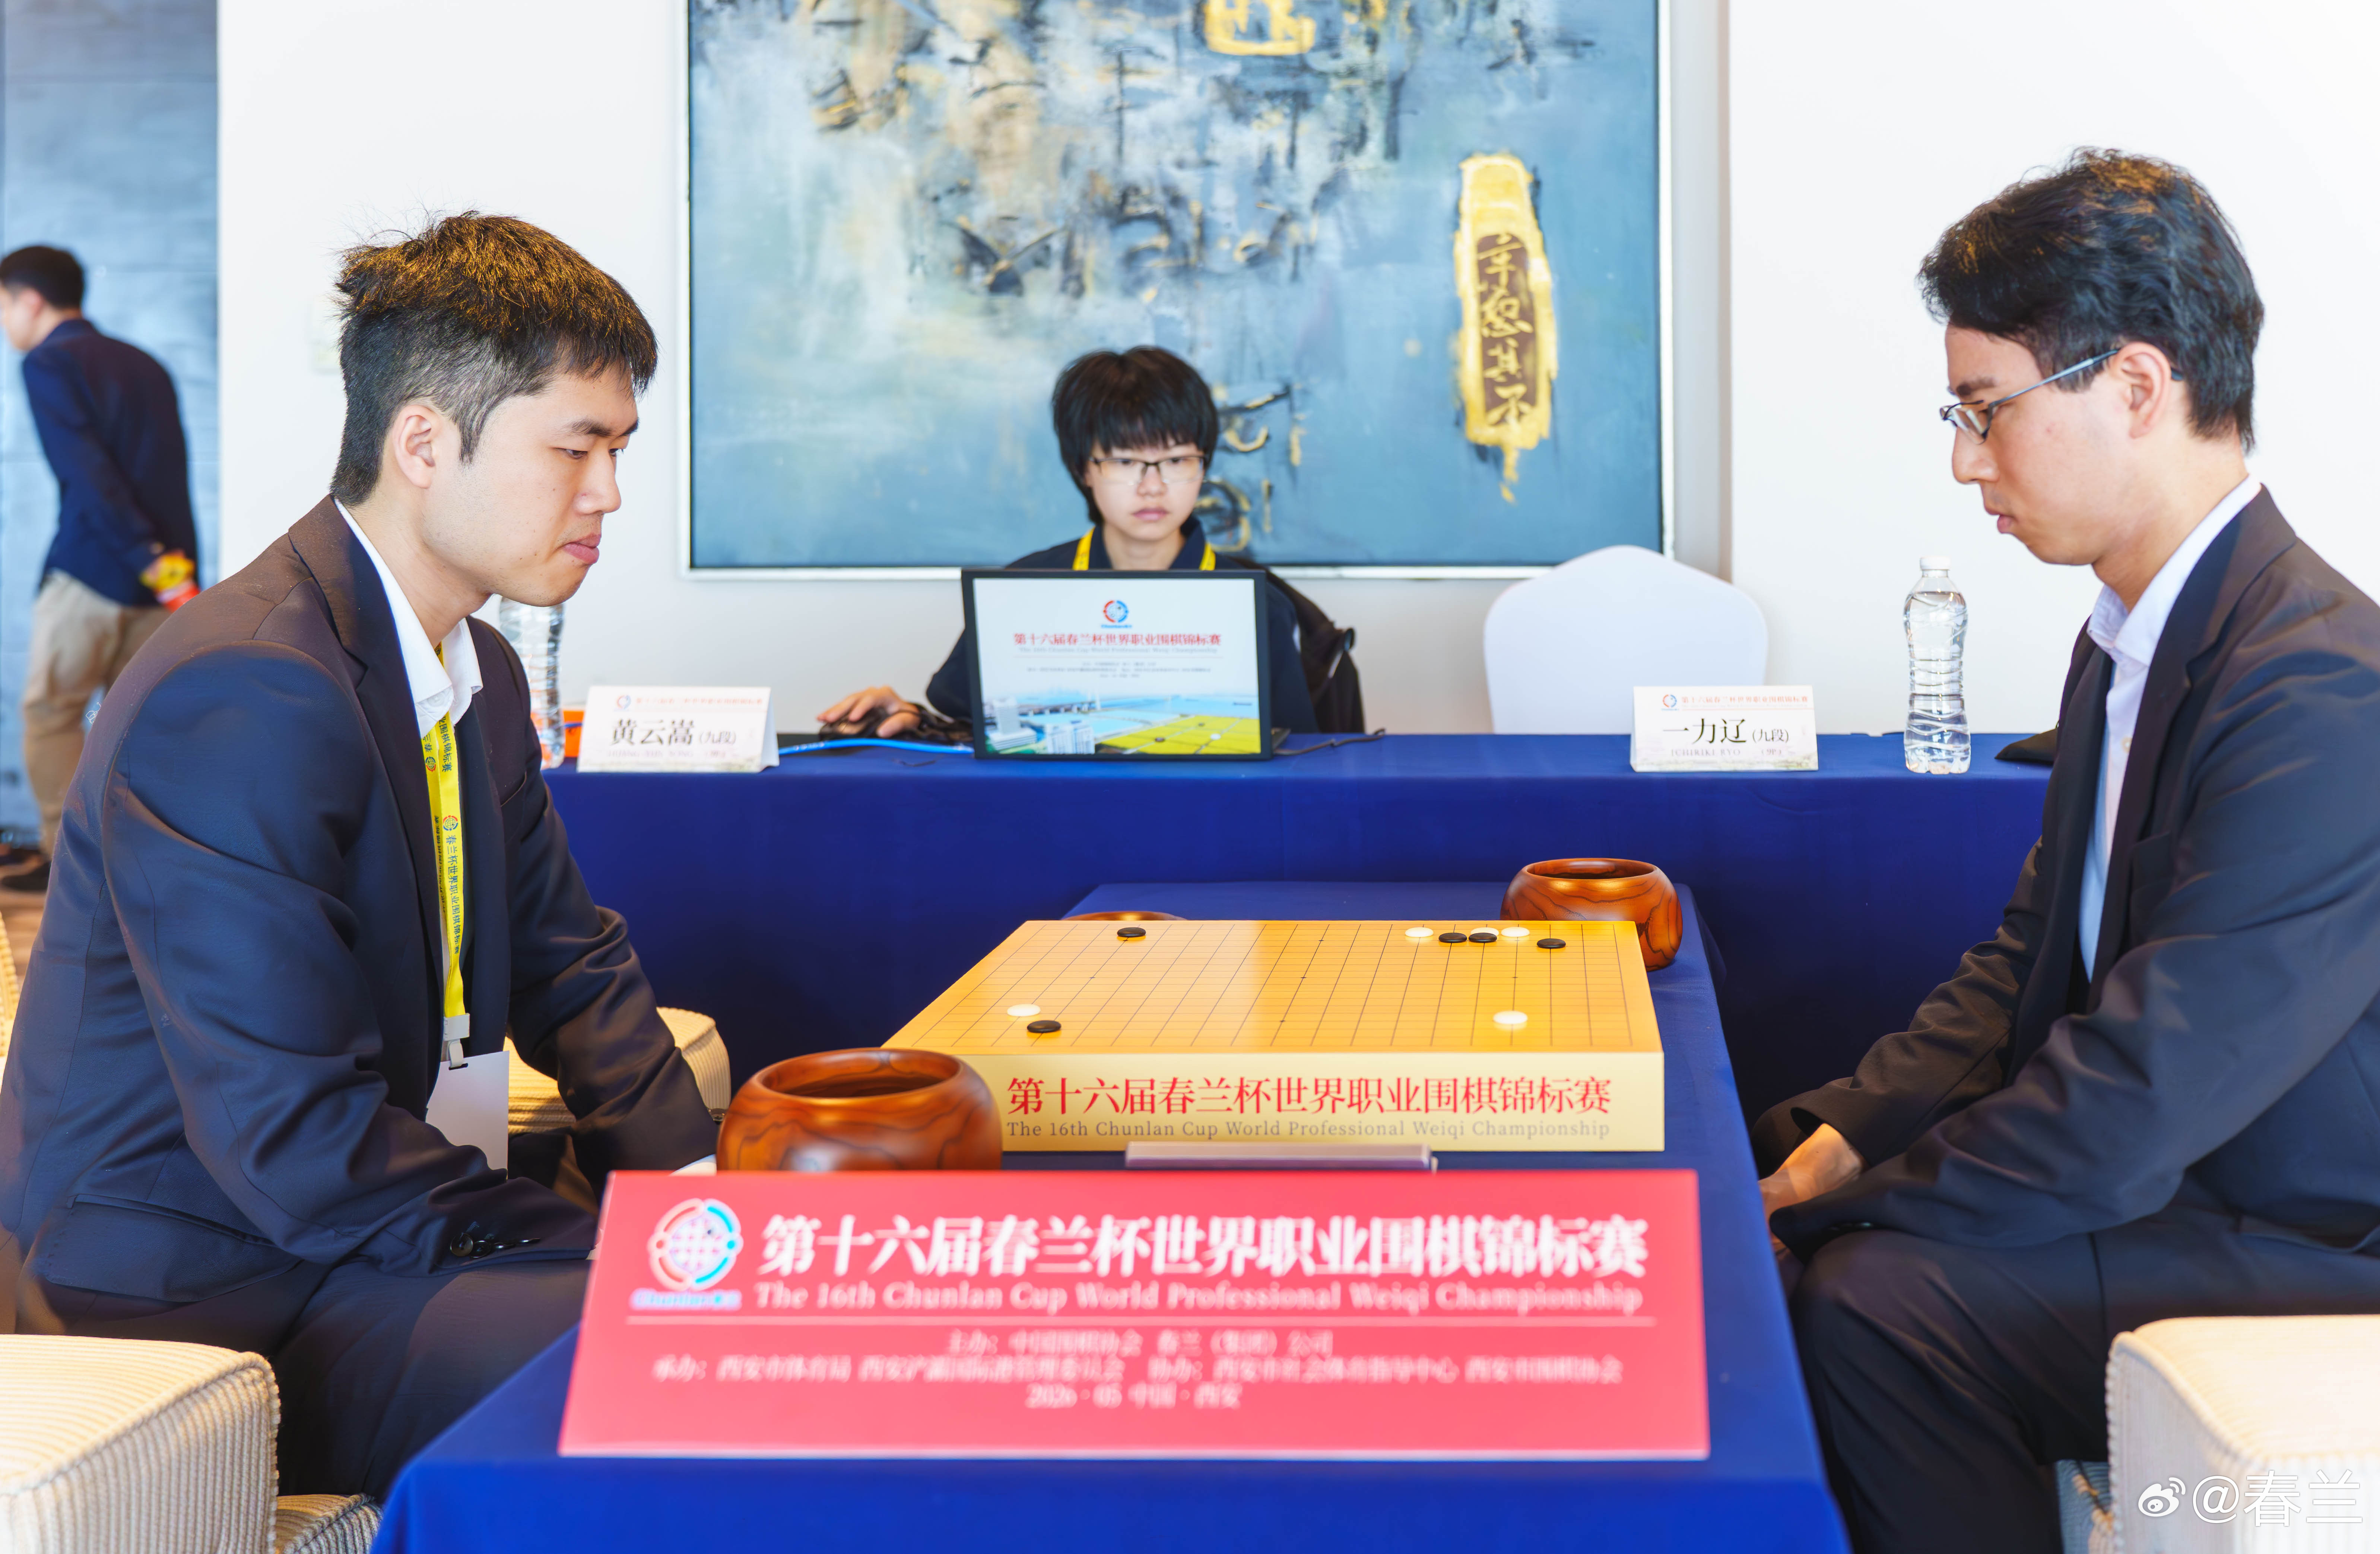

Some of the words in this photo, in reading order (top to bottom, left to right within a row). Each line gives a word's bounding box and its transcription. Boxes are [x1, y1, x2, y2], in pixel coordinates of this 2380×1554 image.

[1014, 633, 1222, 646] 第十六届春兰杯世界职业围棋锦标赛
[610, 718, 695, 746] 黄云嵩
[1663, 718, 1747, 744] 一力辽
[446, 834, 460, 955] 春兰杯世界职业围棋锦标赛
[1007, 1076, 1611, 1115] 第十六届春兰杯世界职业围棋锦标赛
[1007, 1121, 1041, 1136] The
[1050, 1121, 1088, 1136] 16th
[1096, 1121, 1174, 1136] Chunlan
[1182, 1121, 1218, 1140] Cup
[1226, 1121, 1280, 1136] World
[1289, 1120, 1404, 1136] Professional
[1413, 1120, 1465, 1140] Weiqi
[1472, 1120, 1610, 1140] Championship
[756, 1213, 1649, 1277] 第十六届春兰杯世界职业围棋锦标赛
[754, 1280, 809, 1309] The
[816, 1280, 876, 1309] 16th
[882, 1280, 1003, 1309] Chunlan
[1010, 1280, 1068, 1316] Cup
[1075, 1280, 1159, 1309] World
[1167, 1280, 1342, 1310] Professional
[1349, 1280, 1429, 1316] Weiqi
[1435, 1280, 1644, 1316] Championship
